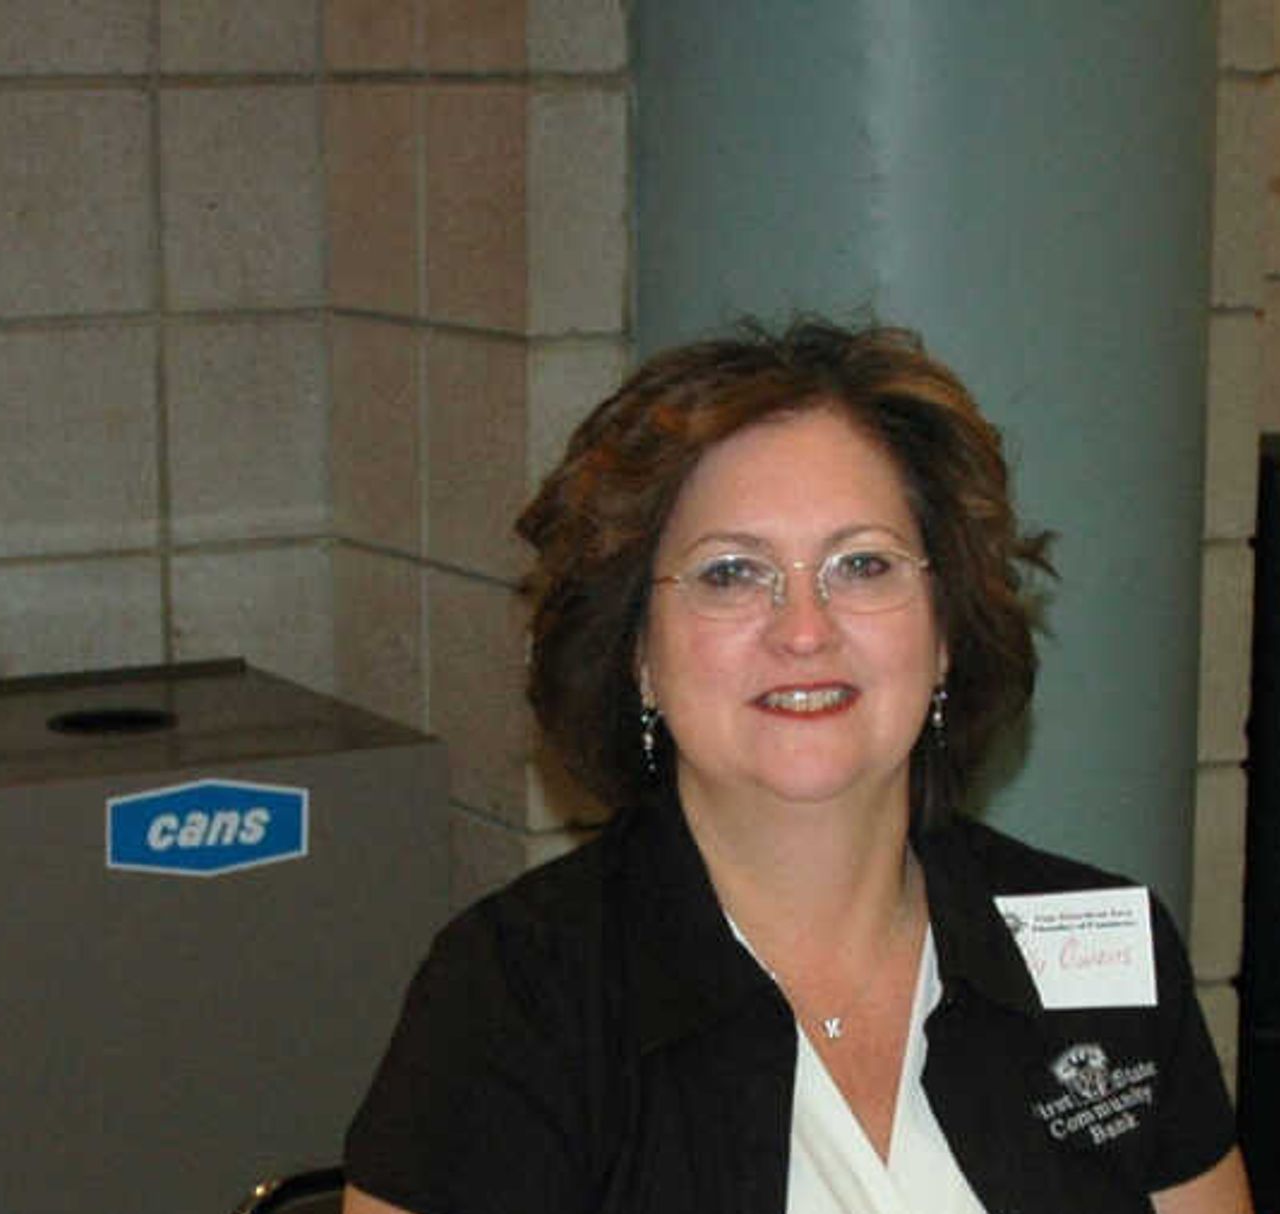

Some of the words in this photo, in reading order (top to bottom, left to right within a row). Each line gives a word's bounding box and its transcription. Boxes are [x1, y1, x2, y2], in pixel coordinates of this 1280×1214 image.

[146, 807, 270, 851] cans
[1049, 1086, 1152, 1141] Community
[1088, 1112, 1141, 1145] Bank
